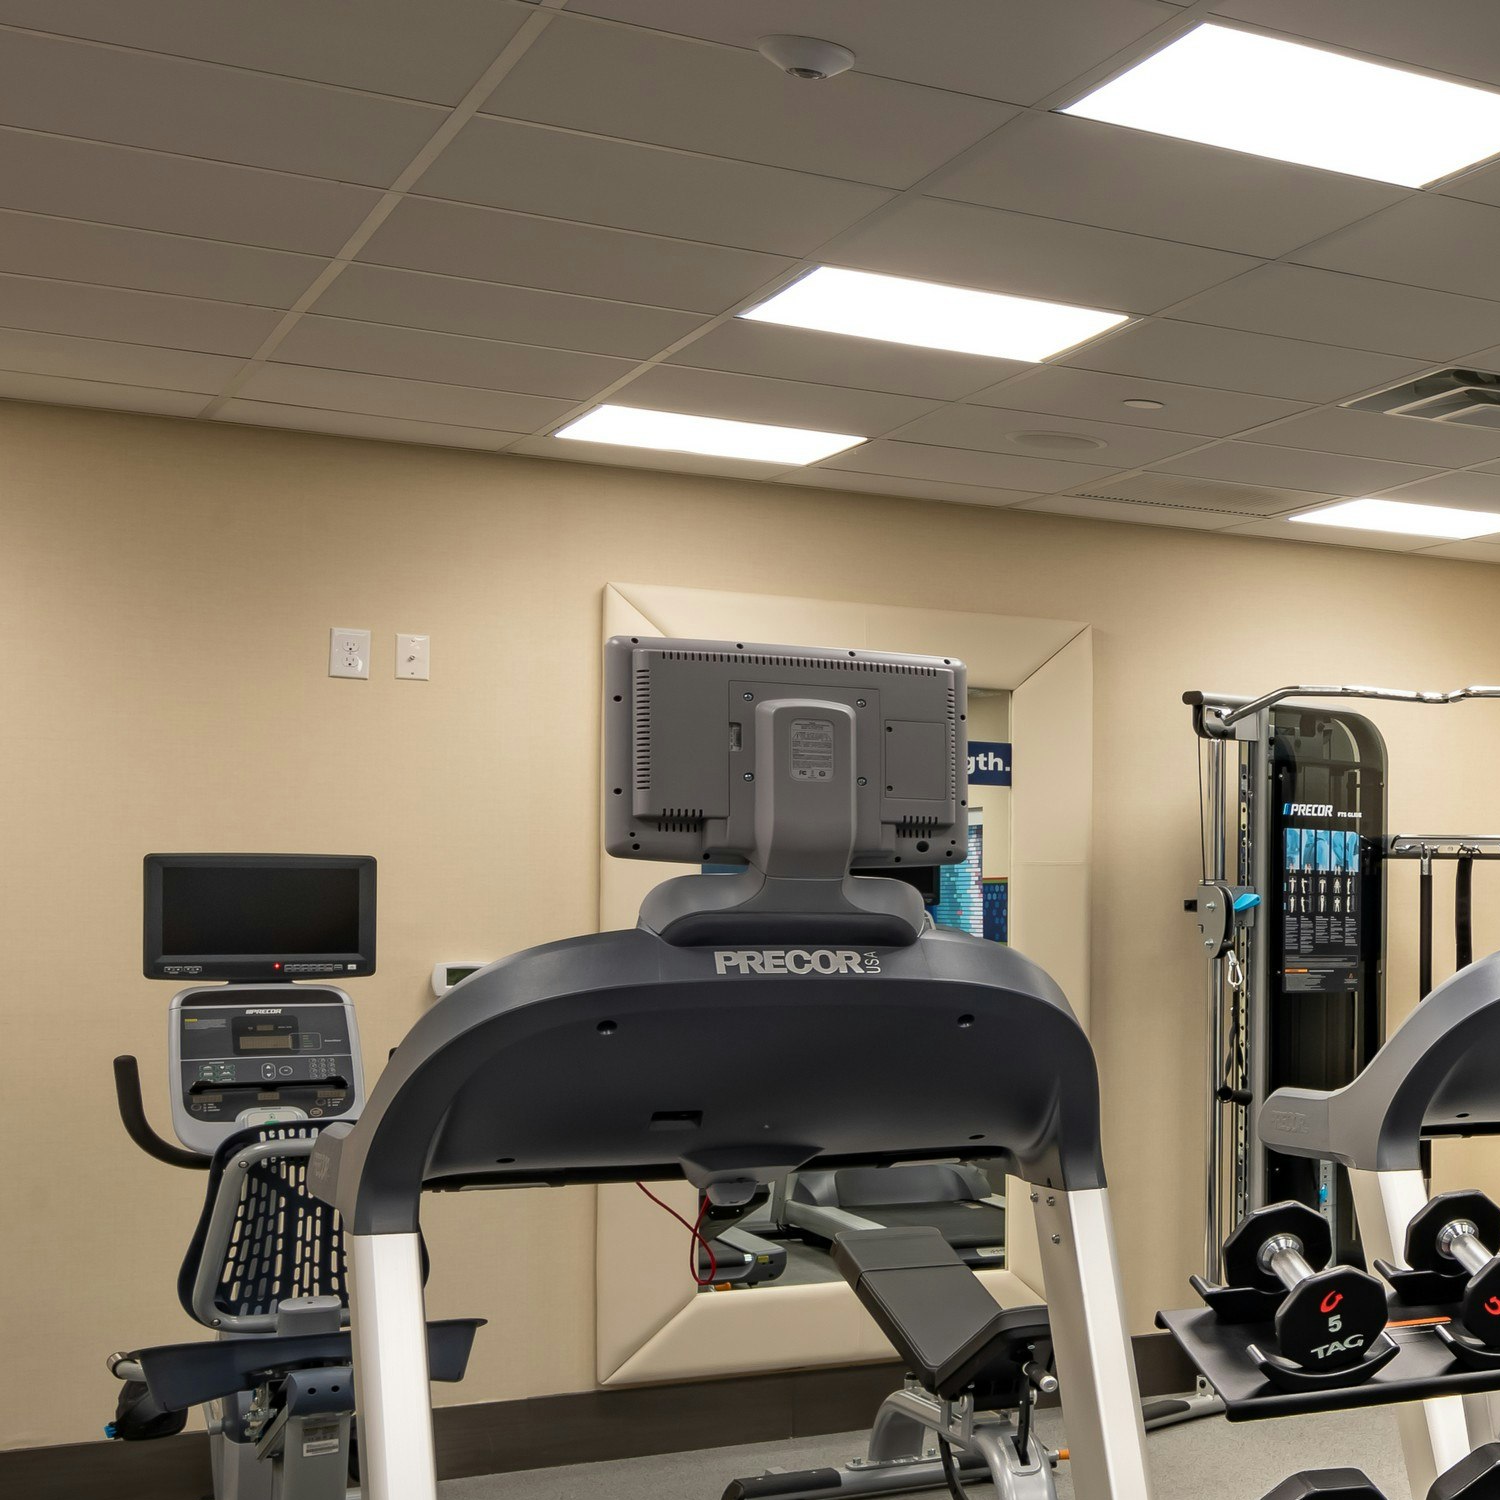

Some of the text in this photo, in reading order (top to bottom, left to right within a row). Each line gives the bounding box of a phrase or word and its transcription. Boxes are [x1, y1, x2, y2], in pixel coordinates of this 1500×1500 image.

[1290, 803, 1333, 817] PRECOR
[714, 949, 881, 975] PRECOR USA
[1329, 1315, 1342, 1332] 5
[1311, 1334, 1363, 1358] TAG
